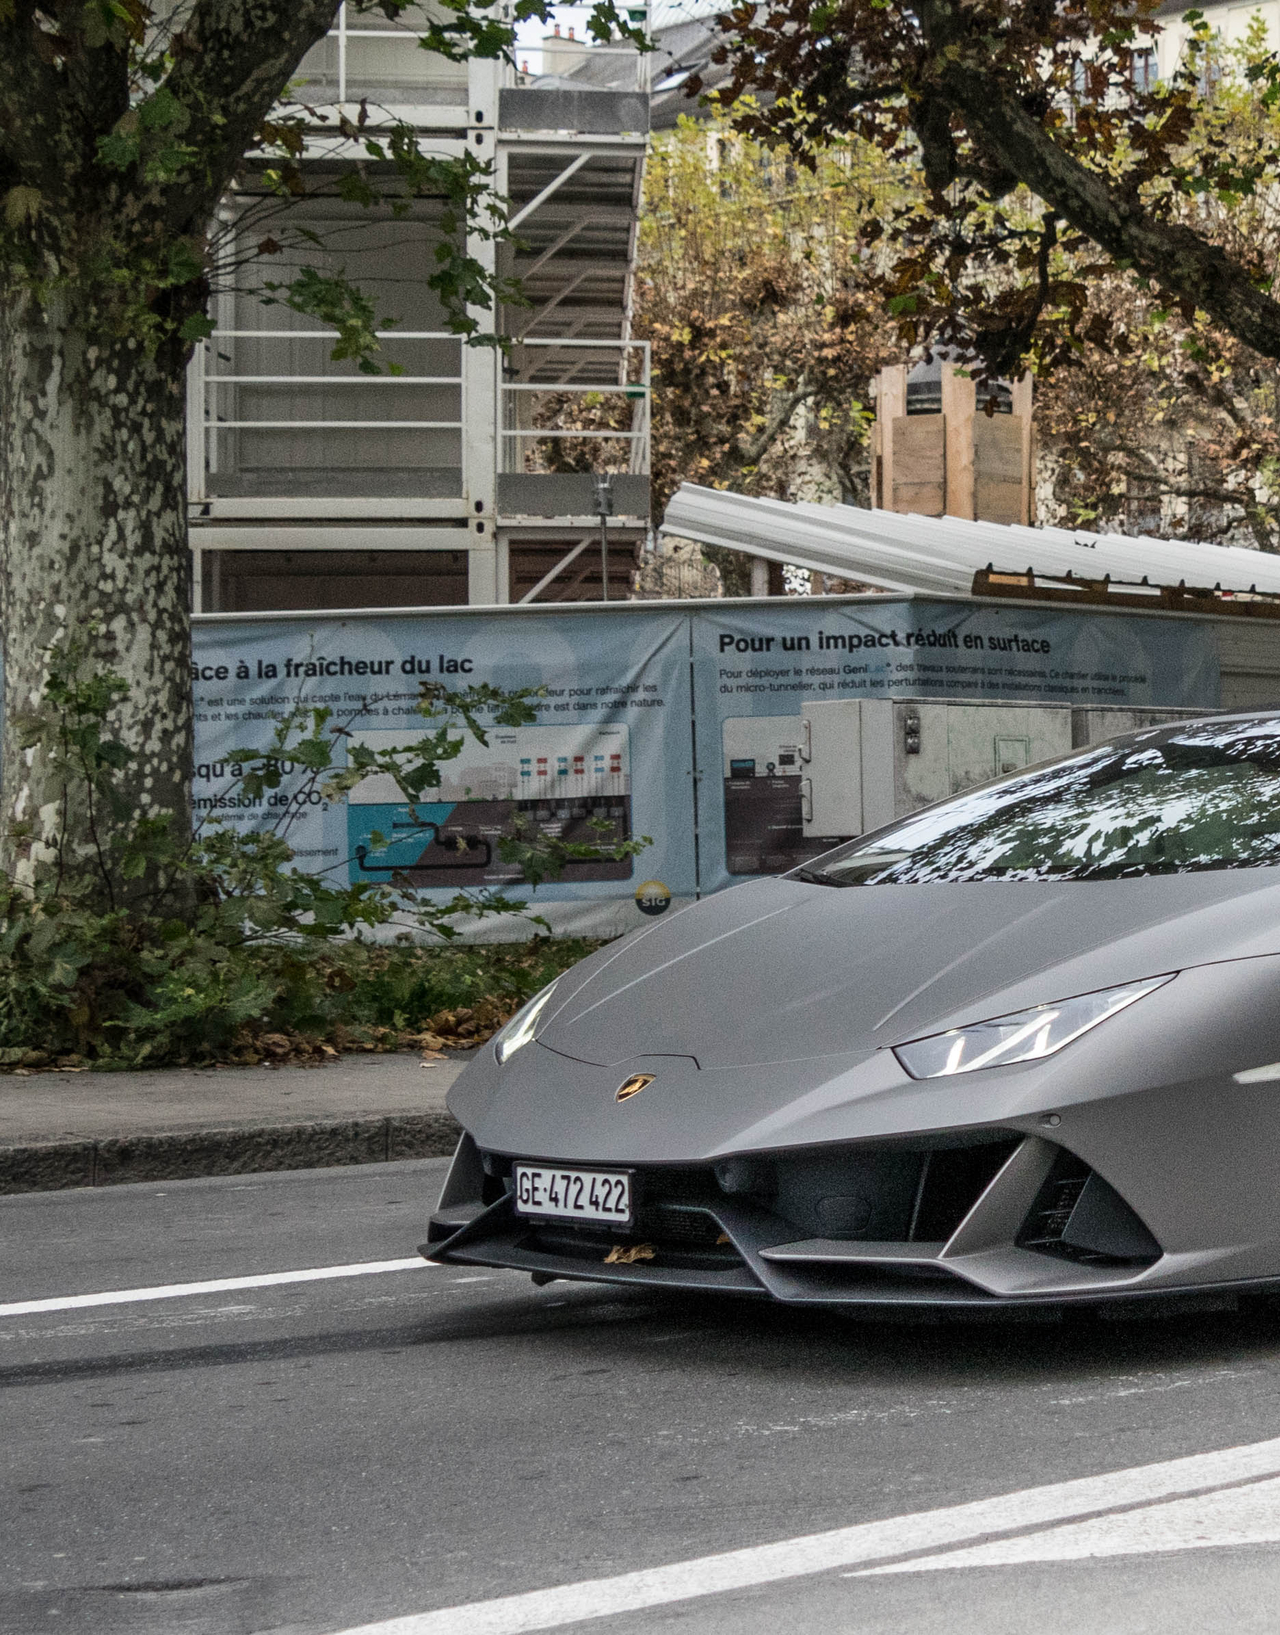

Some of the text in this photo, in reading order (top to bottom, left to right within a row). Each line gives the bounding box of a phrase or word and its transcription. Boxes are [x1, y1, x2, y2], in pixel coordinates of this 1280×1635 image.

[718, 628, 1051, 654] Pour un impact réduit en surface
[190, 654, 473, 681] âce à la fraîcheur du lac
[719, 668, 743, 679] Pour
[746, 665, 791, 680] déployer
[793, 667, 803, 677] le
[805, 665, 840, 676] réseau
[895, 663, 914, 673] des
[568, 687, 593, 698] pour
[642, 683, 657, 693] les
[719, 684, 733, 694] du
[818, 678, 834, 691] qui
[837, 678, 867, 689] réduit
[869, 677, 884, 688] les
[207, 697, 223, 707] est
[226, 697, 246, 706] une
[249, 695, 290, 706] solution
[553, 702, 570, 712] est
[572, 701, 598, 711] dans
[600, 699, 627, 710] notre
[211, 711, 222, 721] et
[224, 711, 240, 721] les
[267, 791, 289, 807] de
[642, 898, 666, 908] SIG
[589, 1176, 627, 1214] 422
